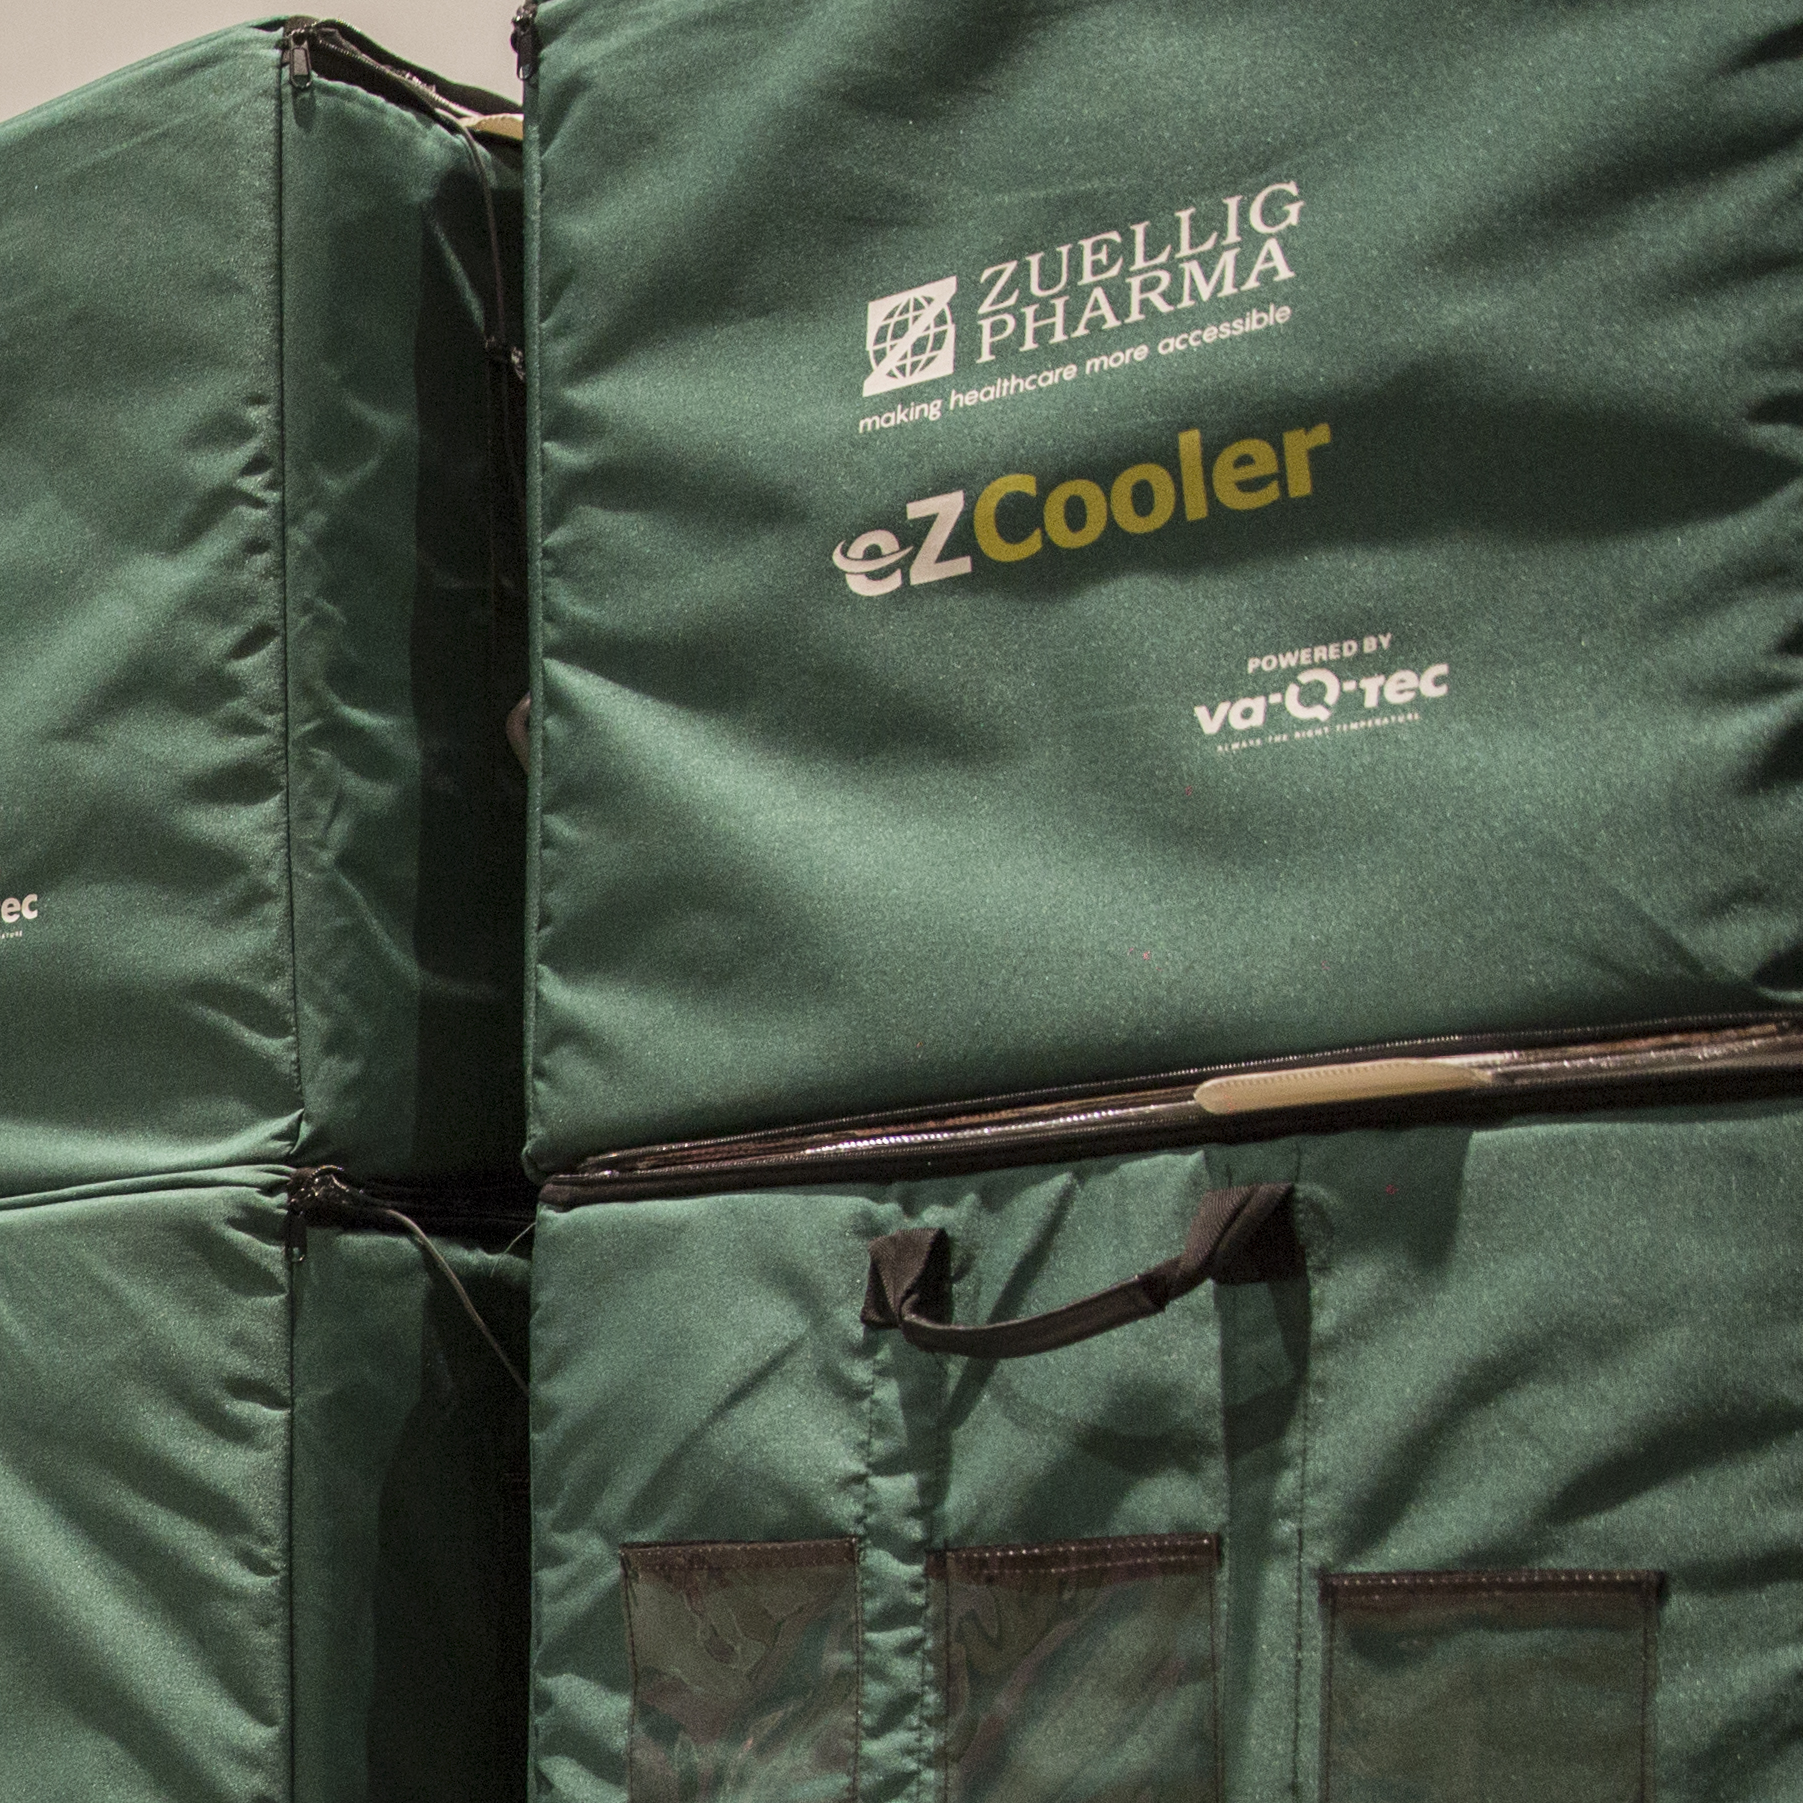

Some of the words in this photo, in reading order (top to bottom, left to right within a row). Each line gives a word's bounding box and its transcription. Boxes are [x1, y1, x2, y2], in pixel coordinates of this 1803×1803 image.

[975, 238, 1296, 363] PHARMA
[977, 181, 1305, 314] ZUELLIG
[858, 399, 942, 434] making
[948, 360, 1077, 411] healthcare
[1085, 342, 1149, 375] more
[1157, 301, 1293, 355] accessible
[1247, 640, 1358, 674] POWERED
[1363, 632, 1392, 653] BY
